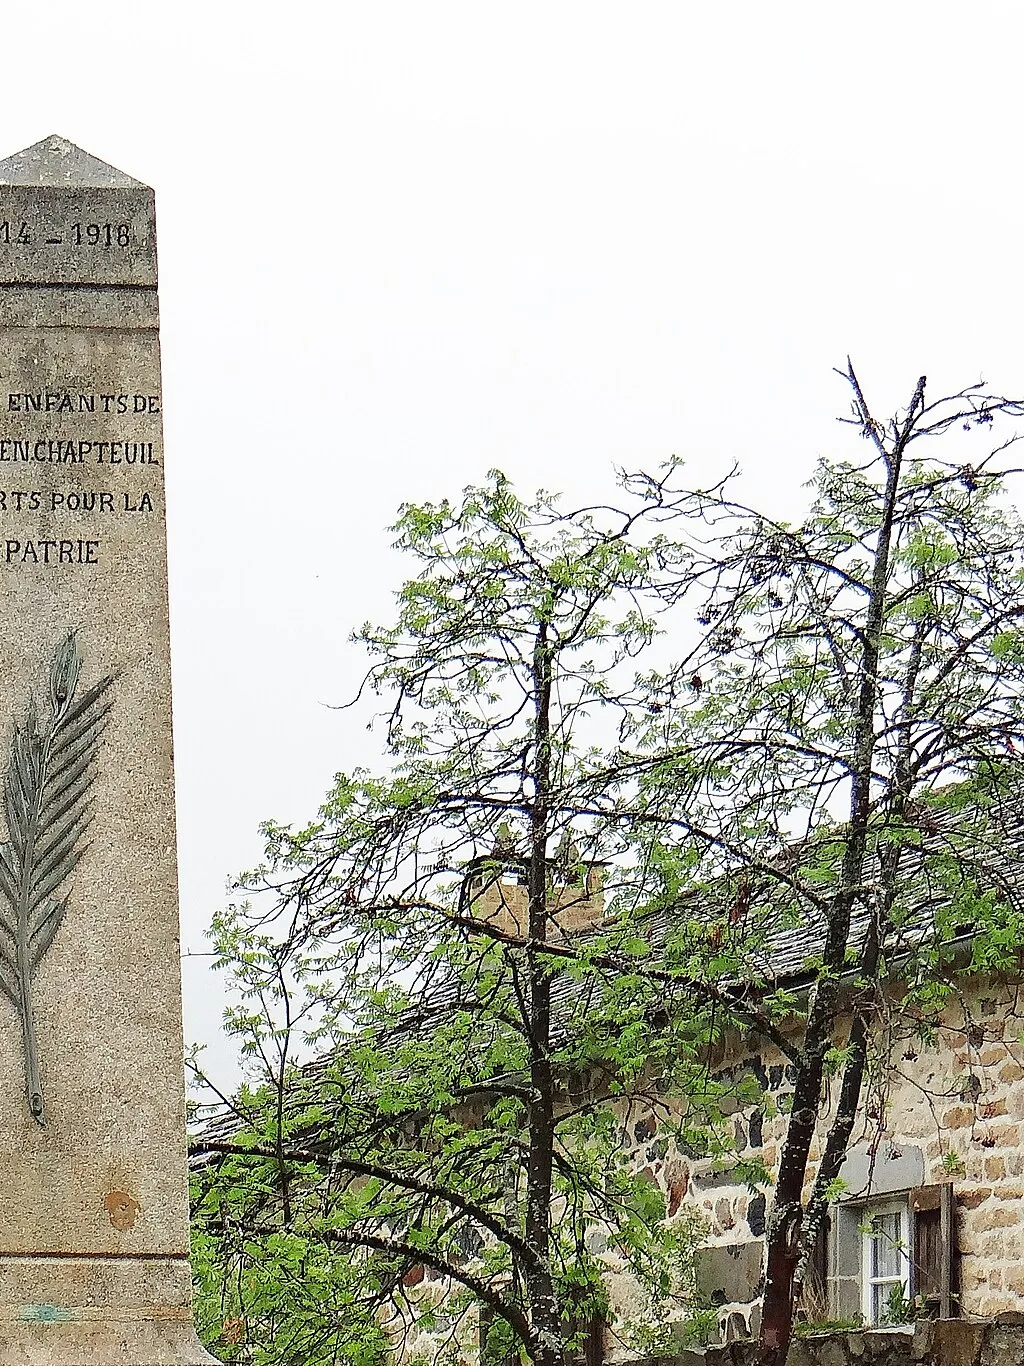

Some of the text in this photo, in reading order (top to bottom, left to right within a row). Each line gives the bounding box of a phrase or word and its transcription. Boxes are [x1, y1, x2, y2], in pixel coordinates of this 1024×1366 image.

[71, 224, 130, 247] 1918
[8, 394, 126, 413] ENFANTS
[134, 395, 160, 414] DE
[52, 493, 114, 512] POUR
[124, 493, 153, 512] LA
[6, 540, 99, 563] PATRIE
